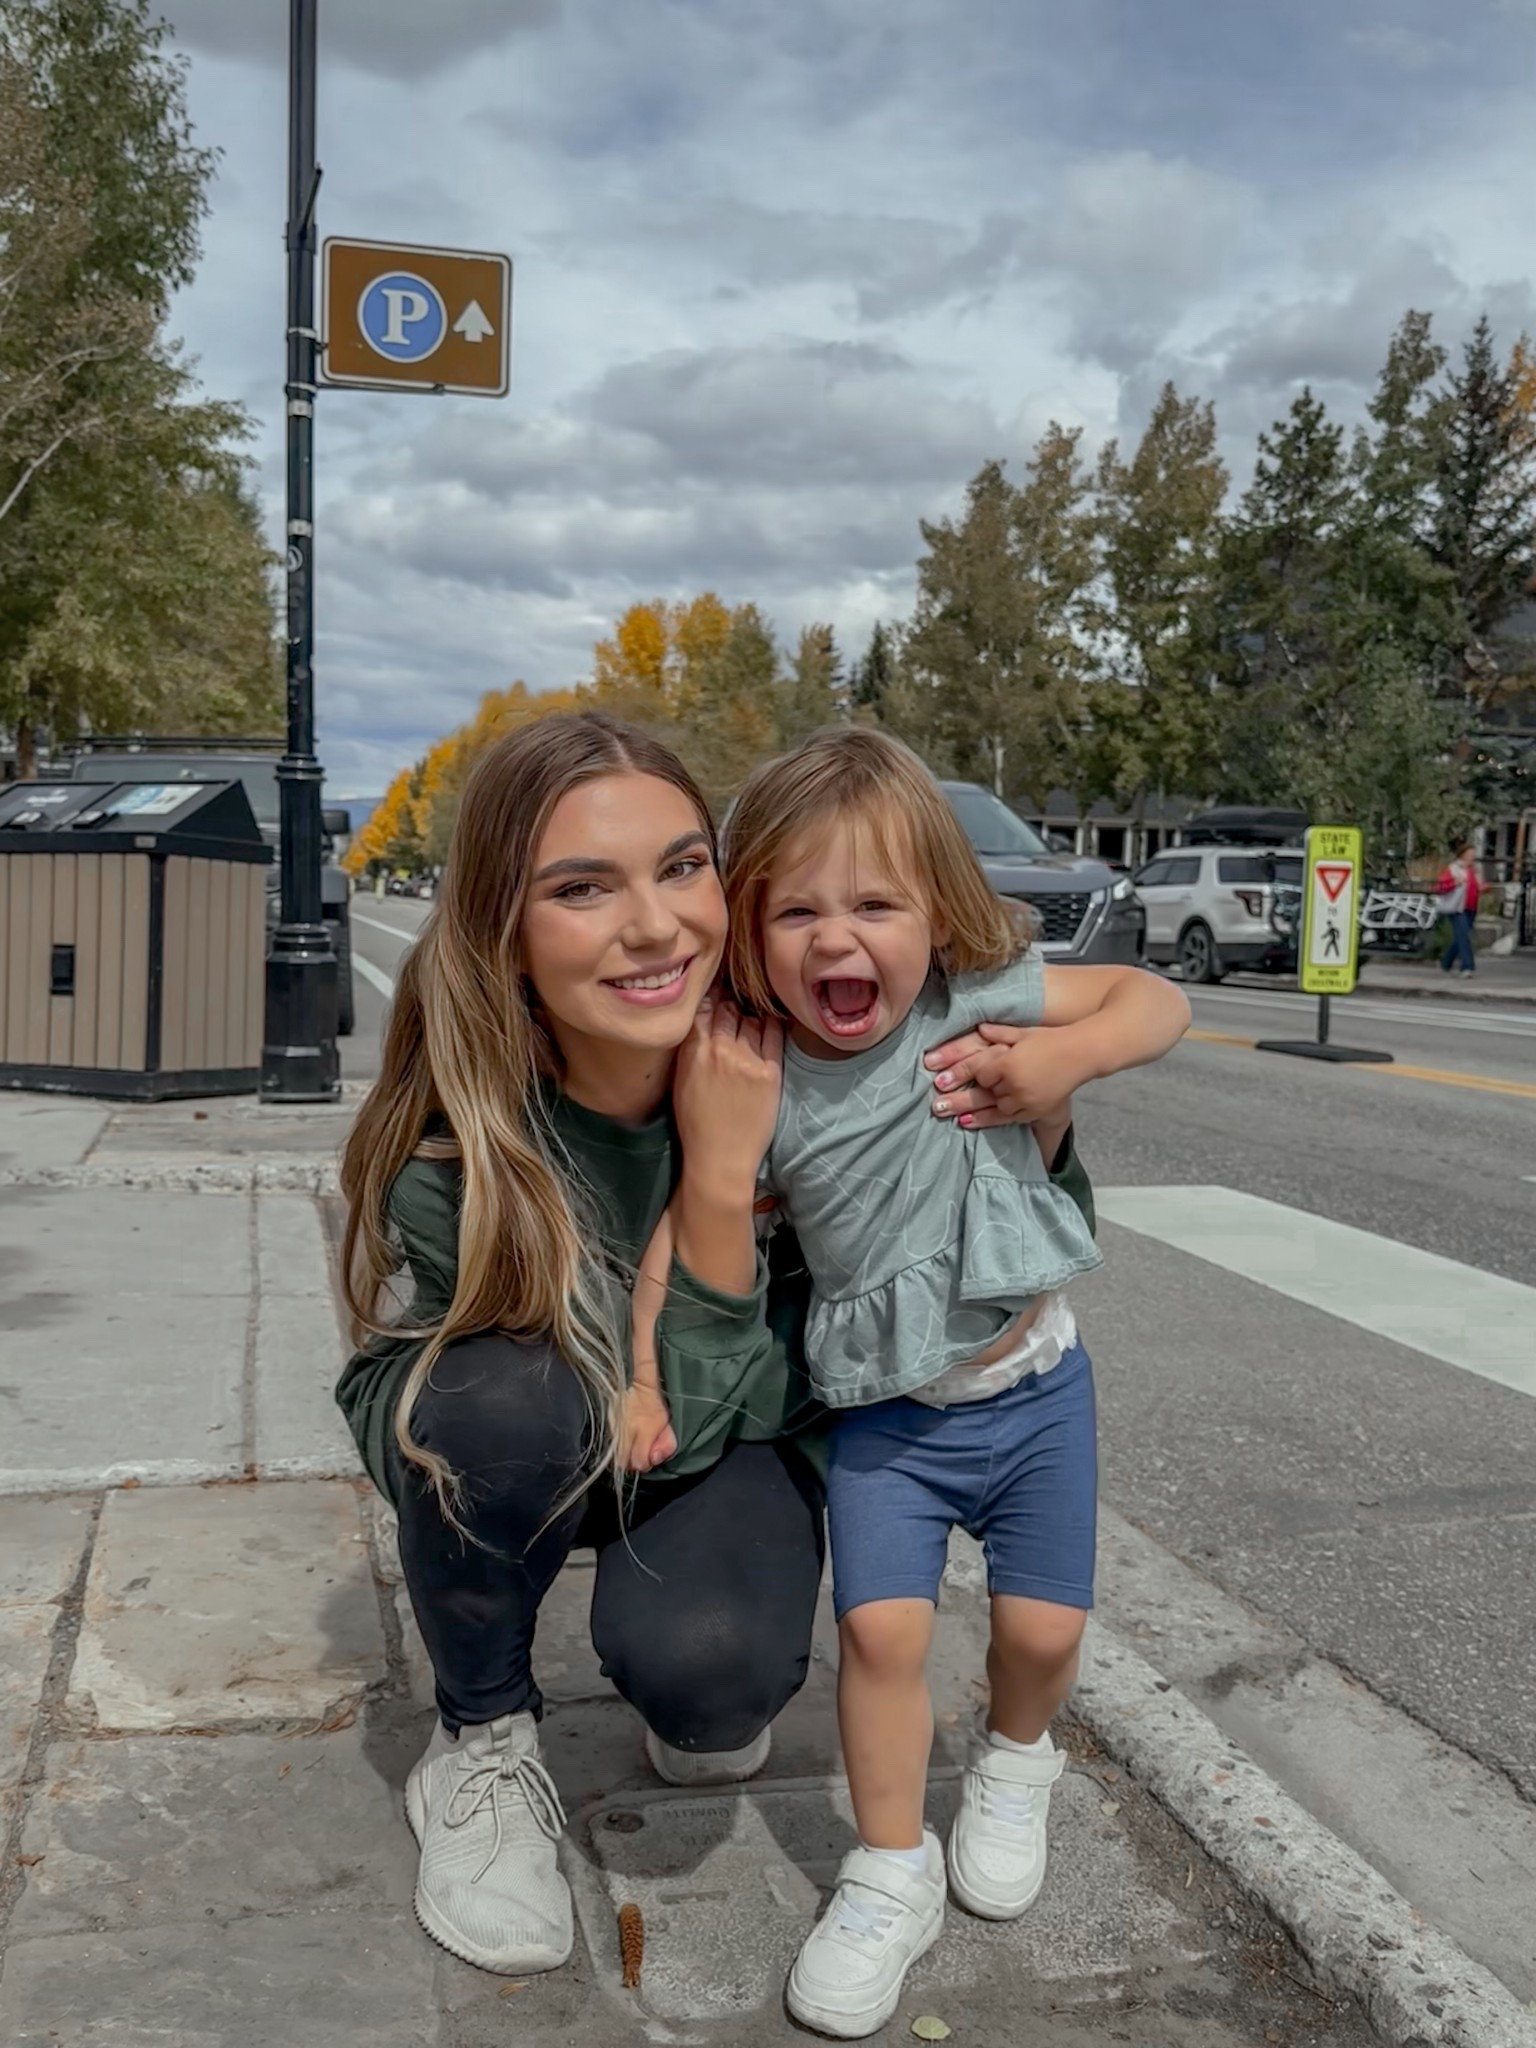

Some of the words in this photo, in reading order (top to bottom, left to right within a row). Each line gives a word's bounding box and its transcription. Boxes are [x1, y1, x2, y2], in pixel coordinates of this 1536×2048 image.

[381, 288, 430, 345] P
[1320, 832, 1350, 845] STATE
[1323, 844, 1346, 856] LAW
